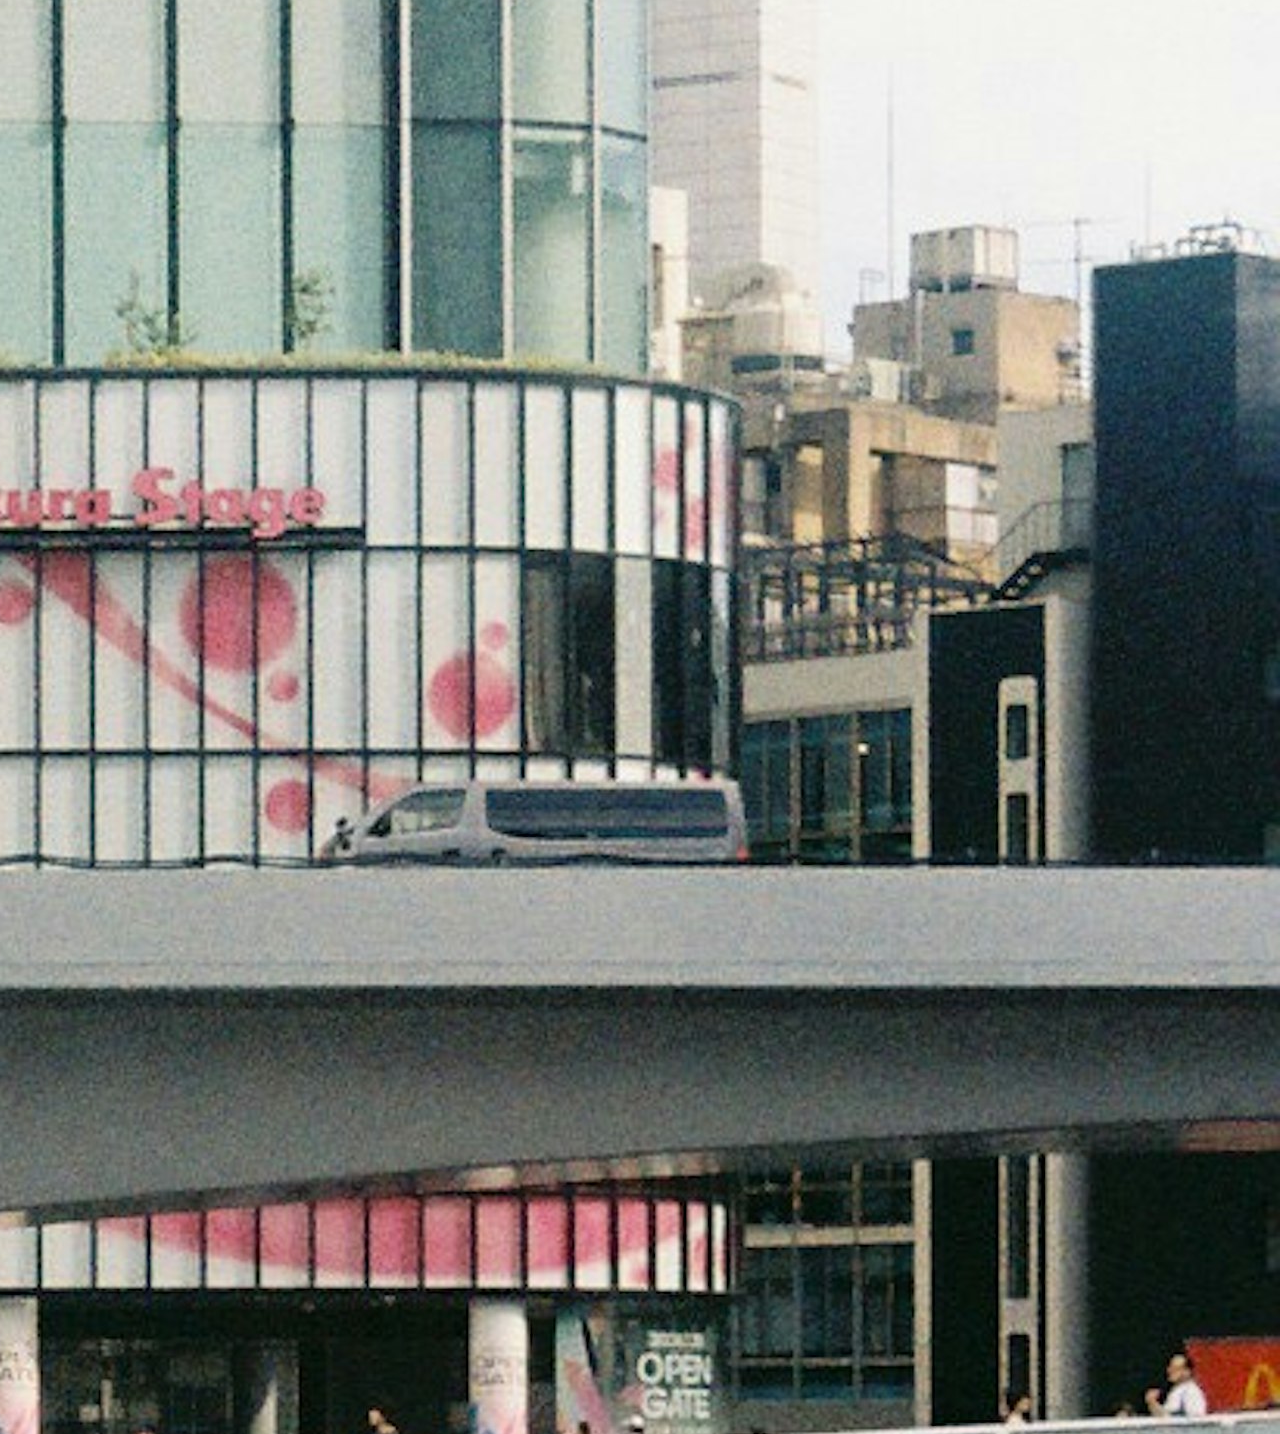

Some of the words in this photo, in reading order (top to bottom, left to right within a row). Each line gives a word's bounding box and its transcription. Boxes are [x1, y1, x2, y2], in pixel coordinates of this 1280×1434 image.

[132, 468, 326, 540] Stage
[636, 1350, 712, 1385] OPEN
[642, 1388, 711, 1420] GATE
